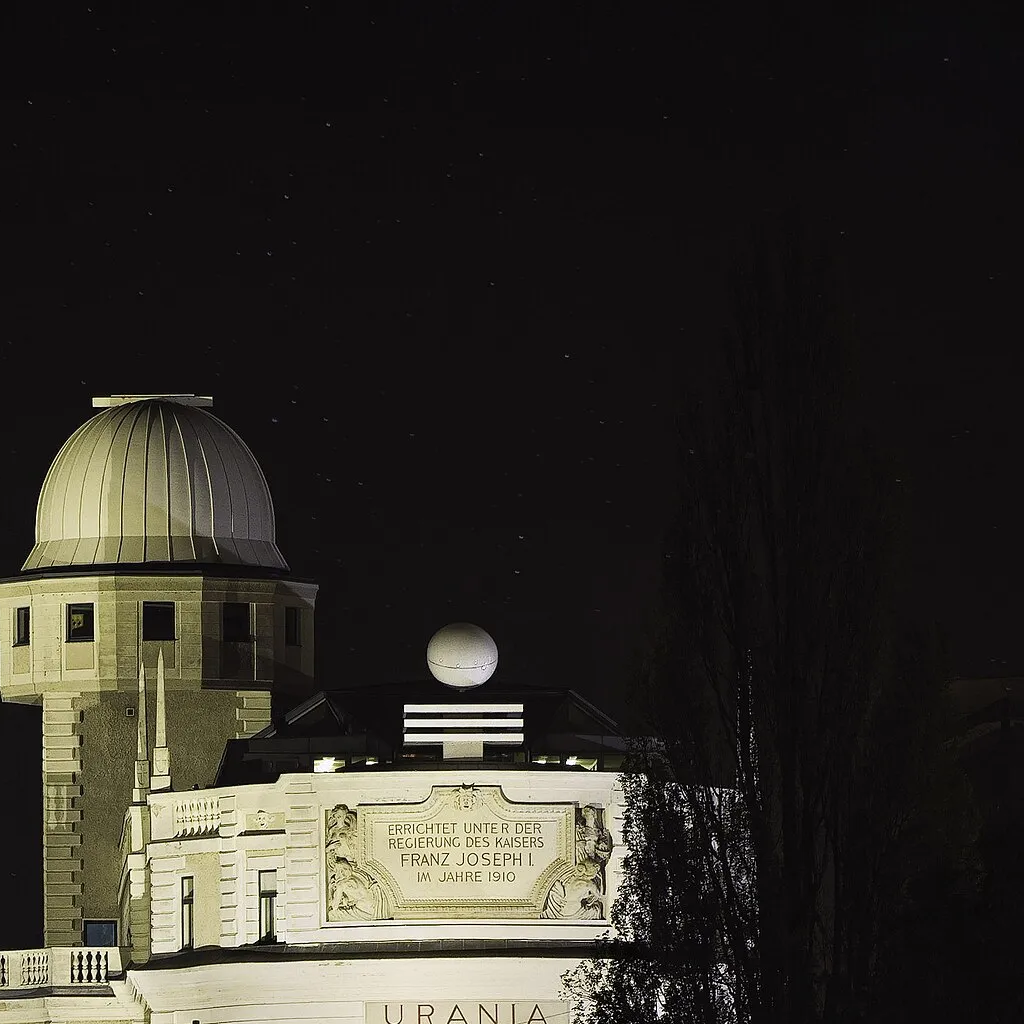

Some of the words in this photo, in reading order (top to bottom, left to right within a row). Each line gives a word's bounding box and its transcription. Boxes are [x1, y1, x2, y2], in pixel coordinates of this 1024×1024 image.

[388, 822, 458, 836] ERRICHTET
[464, 822, 509, 834] UNTER
[515, 822, 542, 834] DER
[388, 836, 461, 849] REGIERUNG
[466, 836, 490, 848] DES
[495, 836, 545, 848] KAISERS
[401, 852, 450, 867] FRANZ
[456, 852, 522, 867] JOSEPH
[417, 871, 431, 883] IM
[438, 871, 482, 883] JAHRE
[488, 871, 516, 883] 1910
